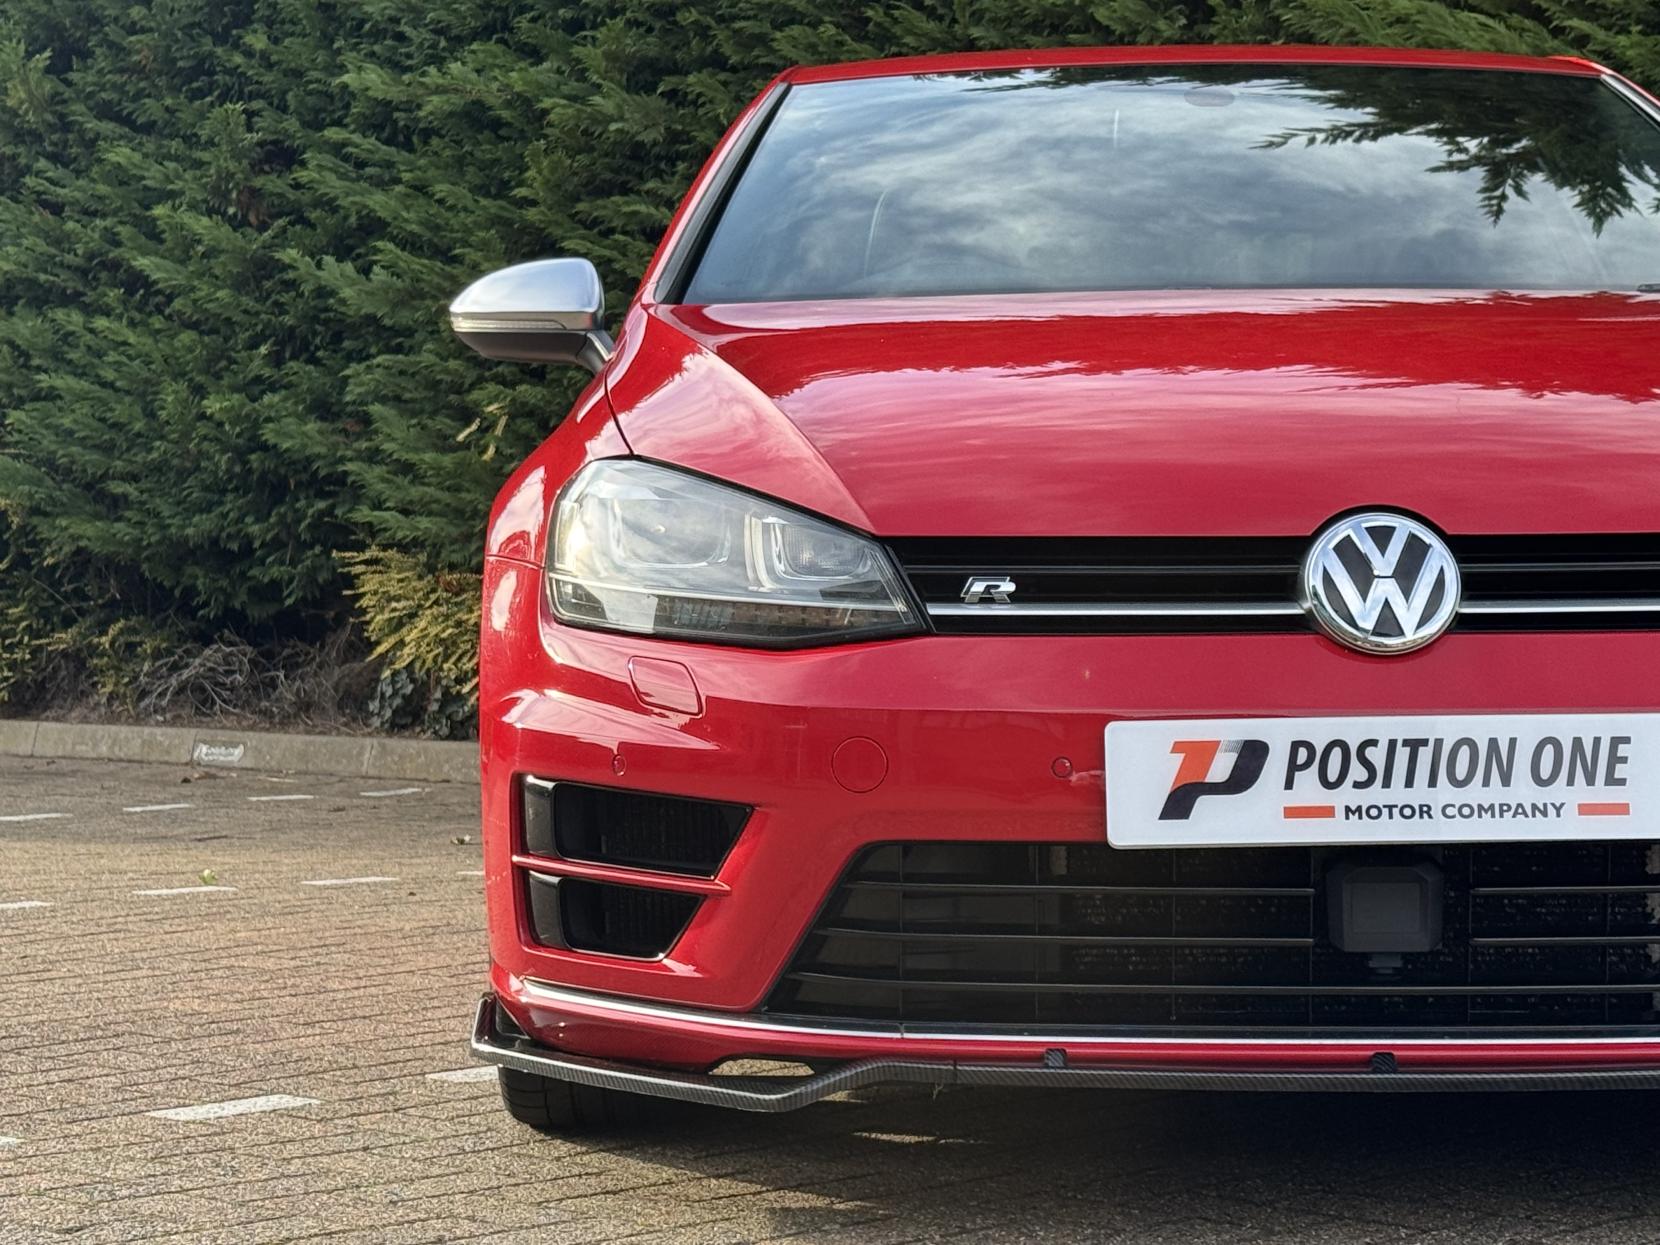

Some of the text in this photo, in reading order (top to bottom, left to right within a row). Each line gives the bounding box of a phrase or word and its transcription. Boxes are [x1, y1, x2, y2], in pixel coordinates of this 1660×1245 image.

[961, 577, 1016, 602] R
[1283, 735, 1632, 791] POSITION ONE
[1344, 802, 1567, 821] MOTOR COMPANY
